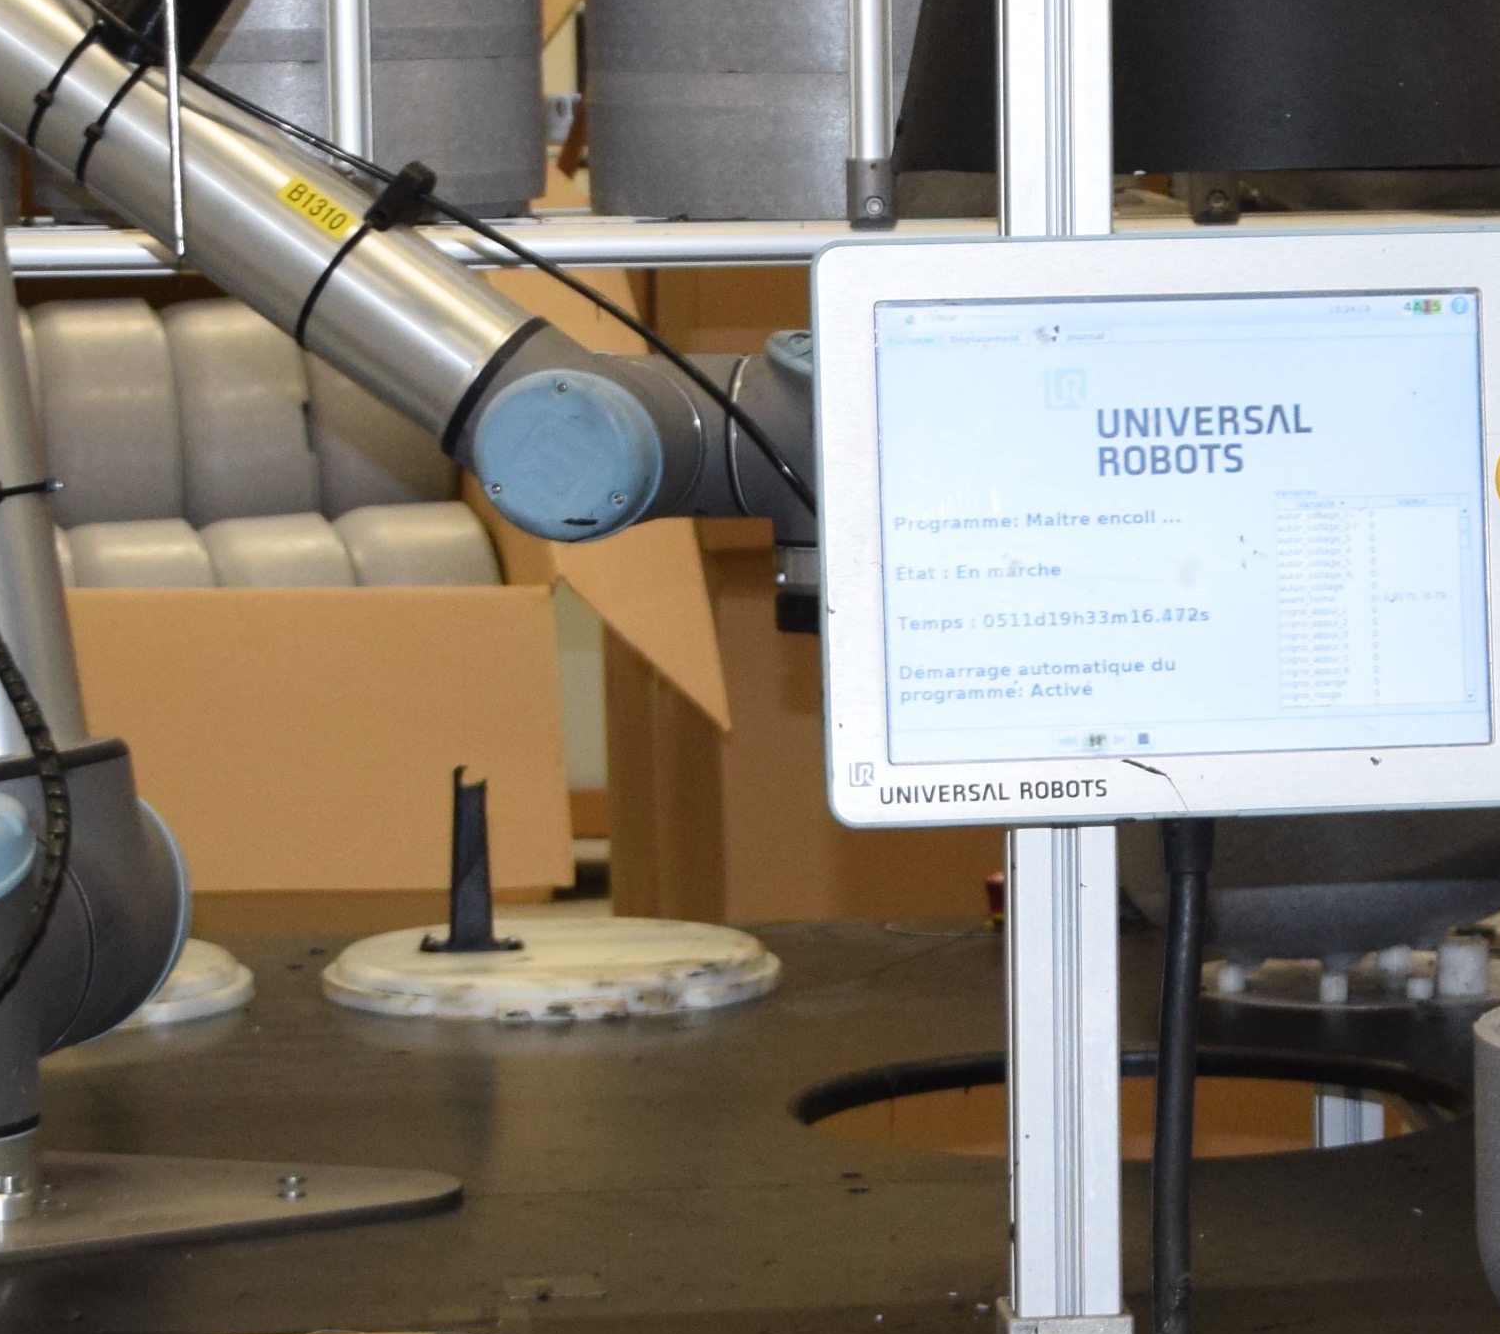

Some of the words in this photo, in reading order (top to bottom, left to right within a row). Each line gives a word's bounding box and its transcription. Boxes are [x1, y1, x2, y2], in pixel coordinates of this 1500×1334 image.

[287, 183, 347, 230] B1310
[1097, 403, 1312, 439] UNIVERSAL
[1099, 443, 1243, 477] ROBOTS
[894, 516, 1018, 533] Programme:
[1097, 510, 1155, 525] encoll
[956, 565, 980, 579] En
[987, 563, 1062, 578] marche
[898, 616, 964, 634] Temps
[900, 665, 1011, 682] Démarrage
[1018, 659, 1145, 677] automatique
[1151, 658, 1177, 672] du
[900, 684, 1024, 705] programme:
[1030, 680, 1093, 698] Activé
[879, 781, 1011, 805] UNIVERSAL
[1019, 778, 1108, 799] ROBOTS
